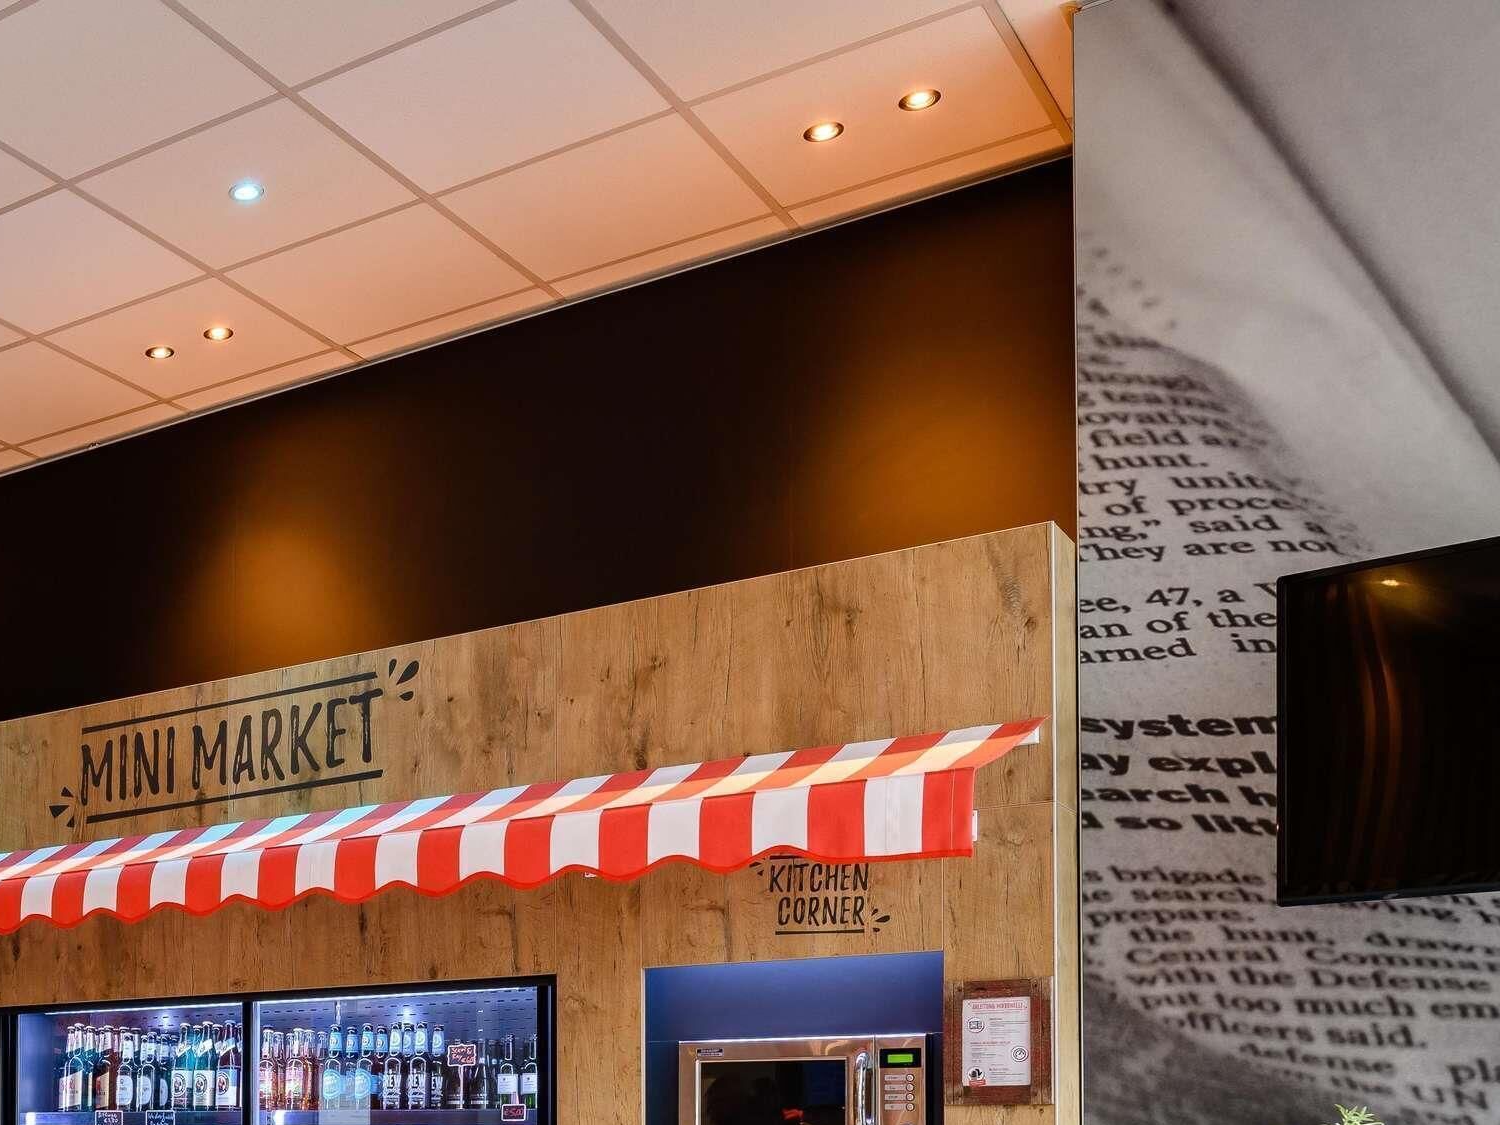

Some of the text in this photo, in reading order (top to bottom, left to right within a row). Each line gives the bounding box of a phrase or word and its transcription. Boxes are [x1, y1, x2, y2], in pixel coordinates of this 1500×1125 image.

[1089, 429, 1190, 447] field
[1090, 453, 1209, 470] hunt.
[1105, 496, 1148, 517] of
[1188, 514, 1282, 534] said
[1182, 540, 1256, 557] are
[1145, 587, 1202, 607] 47,
[1217, 588, 1246, 603] a
[1146, 611, 1191, 635] of
[81, 688, 384, 806] MINI MARKET
[1114, 815, 1183, 831] so
[769, 863, 869, 893] KITCHEN
[1108, 864, 1266, 886] brigade
[1130, 886, 1265, 904] search
[777, 896, 866, 926] CORNER
[1087, 908, 1256, 929] prepare.
[1129, 926, 1196, 944] the
[1219, 923, 1336, 947] hunt.
[1126, 946, 1281, 965] Central
[1126, 966, 1492, 994] with the Defense
[1214, 991, 1282, 1014] too
[1295, 996, 1416, 1018] much
[1326, 1022, 1428, 1049] said.
